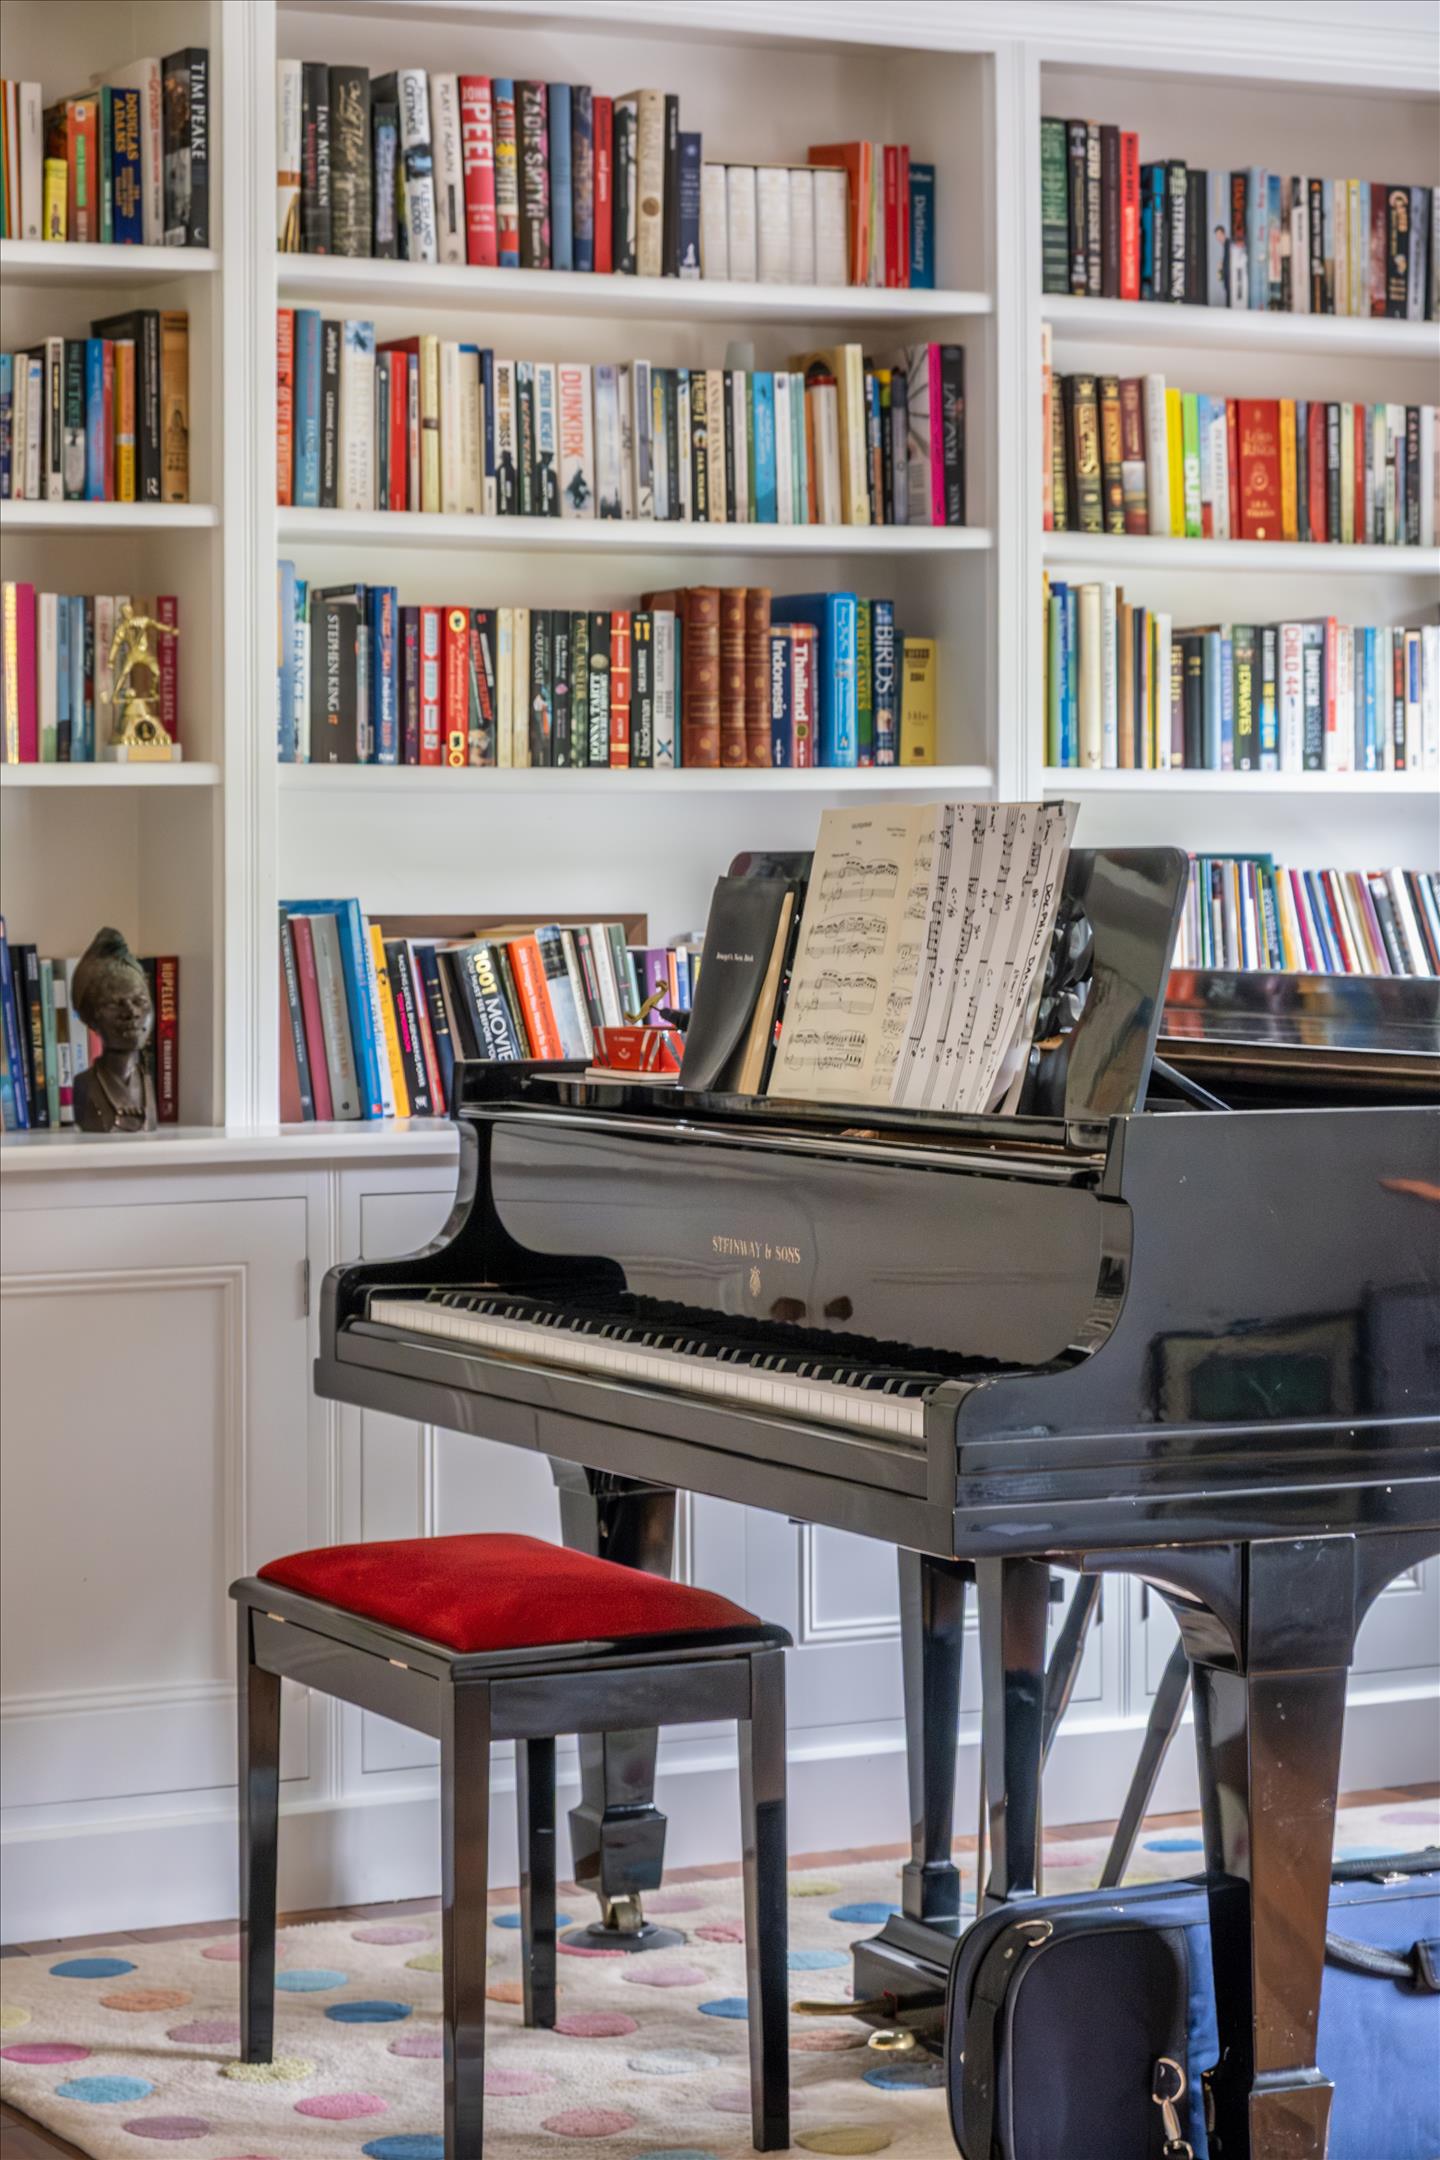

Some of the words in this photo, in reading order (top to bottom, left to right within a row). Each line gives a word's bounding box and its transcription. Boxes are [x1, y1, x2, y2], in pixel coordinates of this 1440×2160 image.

[191, 62, 205, 98] TIM
[115, 99, 125, 152] ADAMS
[126, 93, 138, 160] DOUGLAS
[191, 105, 205, 160] PEAKE
[317, 106, 328, 132] IAN
[440, 84, 450, 112] PLAY
[445, 132, 454, 172] AGAIN
[463, 102, 492, 175] PEEL
[523, 91, 541, 147] ZADIE
[525, 152, 544, 217] SMITH
[1172, 196, 1185, 259] STEPHEN
[1171, 262, 1185, 297] KING
[498, 368, 510, 408] DOUBLE
[499, 412, 511, 447] CROSS
[561, 371, 584, 459] DUNKIRK
[1408, 411, 1418, 462] CAROL
[711, 418, 720, 463] FRANK
[327, 614, 340, 674] STEPHEN
[535, 633, 544, 685] OUTCAST
[875, 625, 893, 694] BIRDS
[1284, 627, 1298, 672] CHILD
[163, 666, 173, 721] CALLBACK
[327, 676, 340, 712] KING
[576, 654, 586, 701] AUSTER
[590, 672, 600, 713] TARTT
[773, 640, 787, 719] Indonesia
[794, 643, 808, 721] Thailand
[1285, 676, 1299, 695] 44
[328, 713, 338, 725] IT
[641, 699, 650, 757] blackman
[1239, 671, 1251, 736] DWARVES
[590, 716, 600, 760] DONNA
[1034, 882, 1054, 946] DOLPHIN
[466, 956, 475, 974] YOU
[470, 975, 481, 997] MUST
[473, 950, 497, 995] 1001
[1015, 955, 1036, 1008] DANCE
[161, 962, 176, 1021] HOPELESS
[371, 1004, 382, 1047] reader
[480, 1014, 491, 1044] BEFORE
[163, 1039, 172, 1070] COLLEEN
[415, 1063, 426, 1088] POWER
[712, 1236, 761, 1258] STEINWAY
[775, 1246, 800, 1264] SONS
